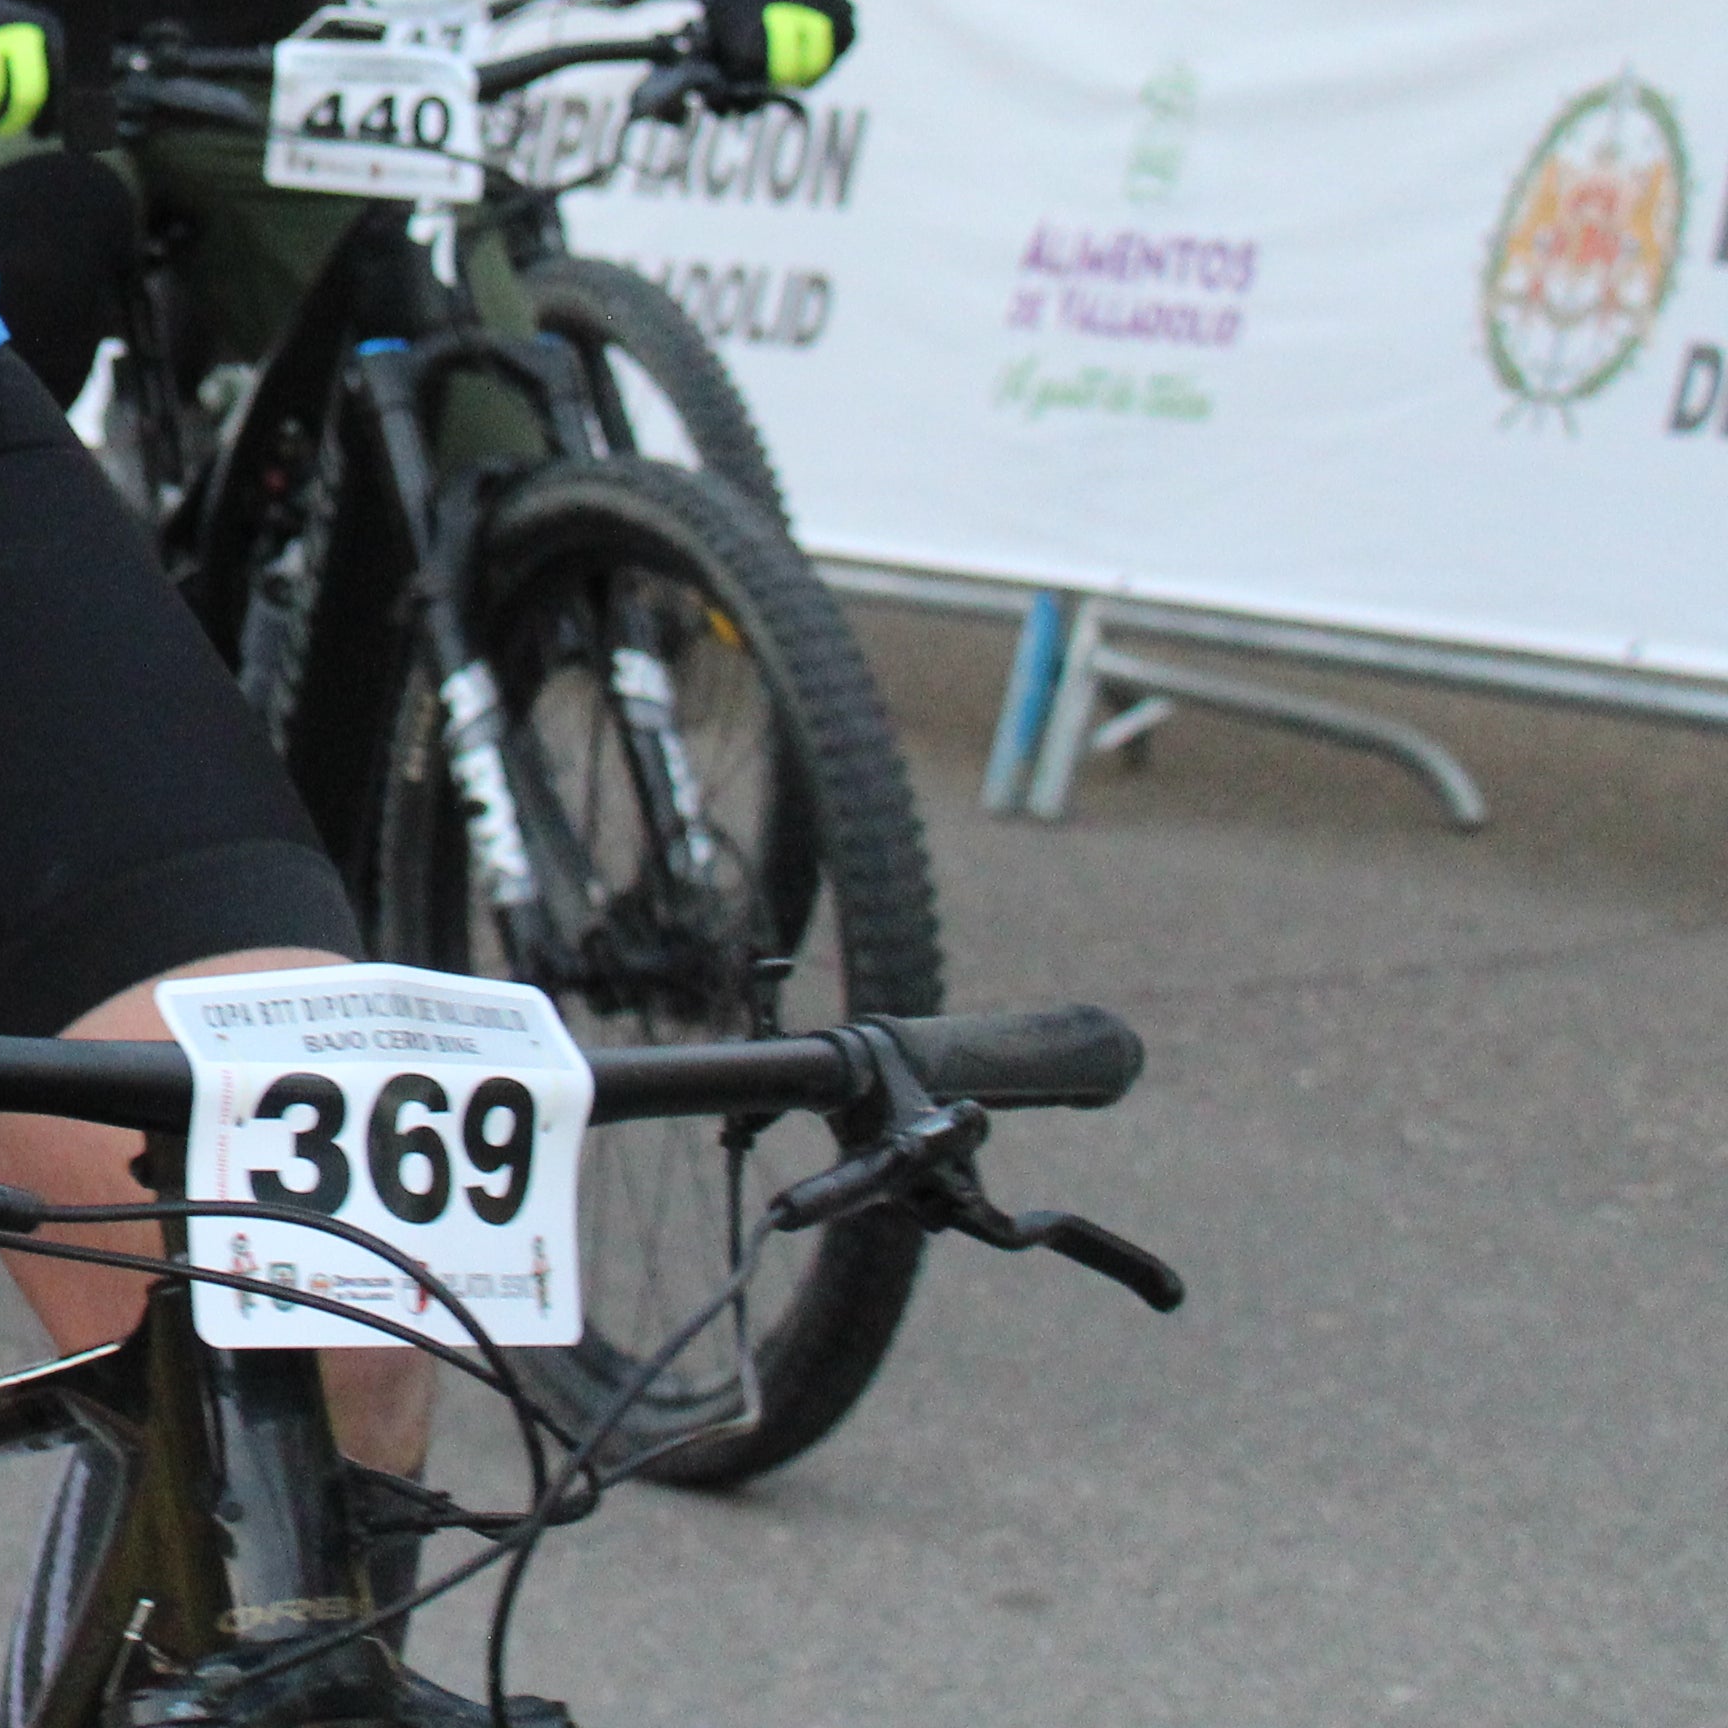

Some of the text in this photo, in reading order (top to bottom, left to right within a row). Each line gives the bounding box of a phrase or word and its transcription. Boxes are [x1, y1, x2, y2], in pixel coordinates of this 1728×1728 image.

[302, 91, 451, 151] 440
[1016, 217, 1260, 294] ALIMENTOS
[1666, 341, 1728, 436] D
[248, 1071, 536, 1226] 369
